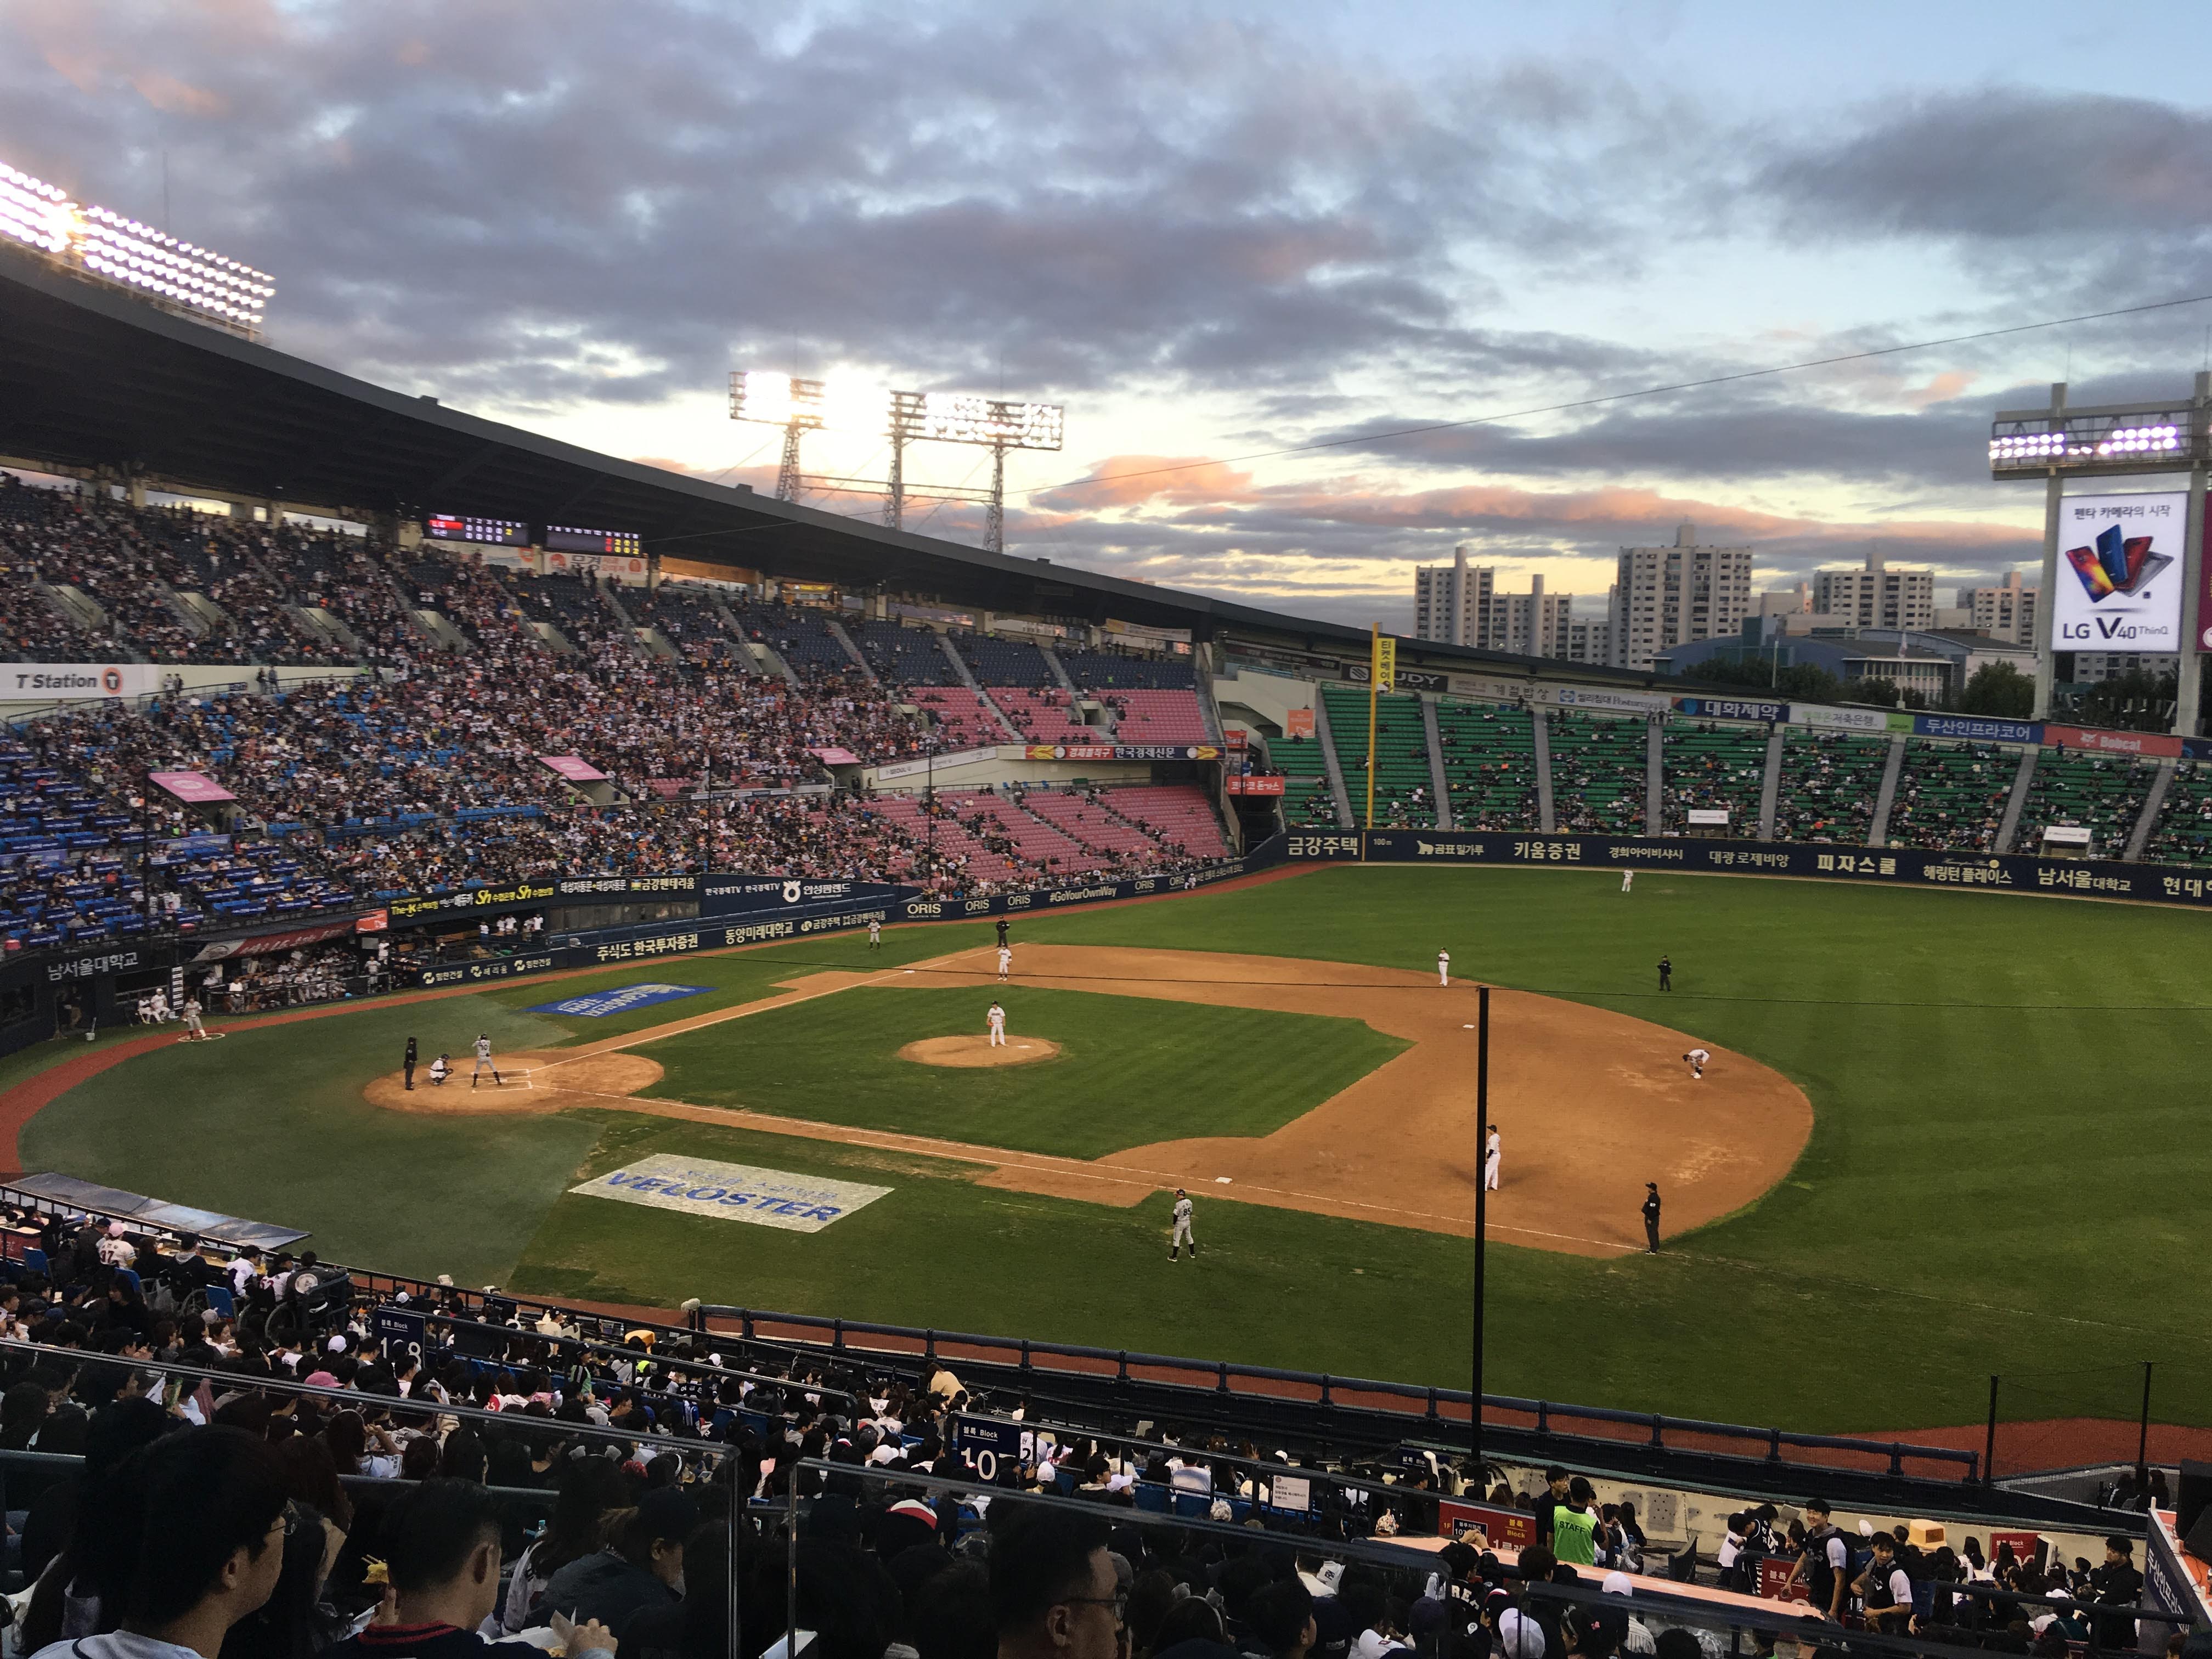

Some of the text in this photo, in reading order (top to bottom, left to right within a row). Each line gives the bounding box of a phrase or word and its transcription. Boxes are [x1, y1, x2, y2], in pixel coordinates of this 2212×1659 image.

[2074, 505, 2171, 520] 펜타 카메라의 시작
[2063, 617, 2168, 639] LG V40 ThinQ
[32, 673, 98, 689] Station
[1394, 673, 1440, 685] UDY
[1705, 701, 1781, 720] 대화제약
[1926, 719, 2030, 741] 두산인프라코어
[1115, 746, 1176, 759] 한국경제신문
[1288, 837, 1358, 856] 금강주택
[1435, 844, 1484, 856] 곰표 밀가루
[1514, 841, 1582, 860] 키움증권
[1709, 851, 1790, 868] 대광 로제비앙
[1817, 854, 1897, 876] 피자스쿨
[1923, 865, 2012, 884] 해링턴 플레이스
[2038, 868, 2132, 891] 남서울대학교
[641, 877, 695, 890] 금강펜테리움
[803, 883, 851, 895] 안성팜랜드
[1135, 879, 1155, 890] ORIS
[1007, 894, 1031, 906] ORIS
[1049, 885, 1117, 903] #GoYourOwnWay
[907, 903, 941, 915] ORIS
[965, 899, 990, 911] ORIS
[813, 916, 840, 929] 금강주택
[725, 922, 794, 945] 동양미래대학교
[597, 933, 698, 961] 주식도 한국투자증권
[48, 952, 139, 981] 남서울대학교
[607, 1172, 842, 1221] VELOSTER
[394, 1321, 408, 1330] Block
[380, 1336, 422, 1365] 18
[980, 1429, 998, 1439] Block
[961, 1447, 1016, 1480] 10
[1509, 1518, 1523, 1528] 블록
[1559, 1520, 1585, 1534] STAFF
[1506, 1530, 1526, 1539] Block
